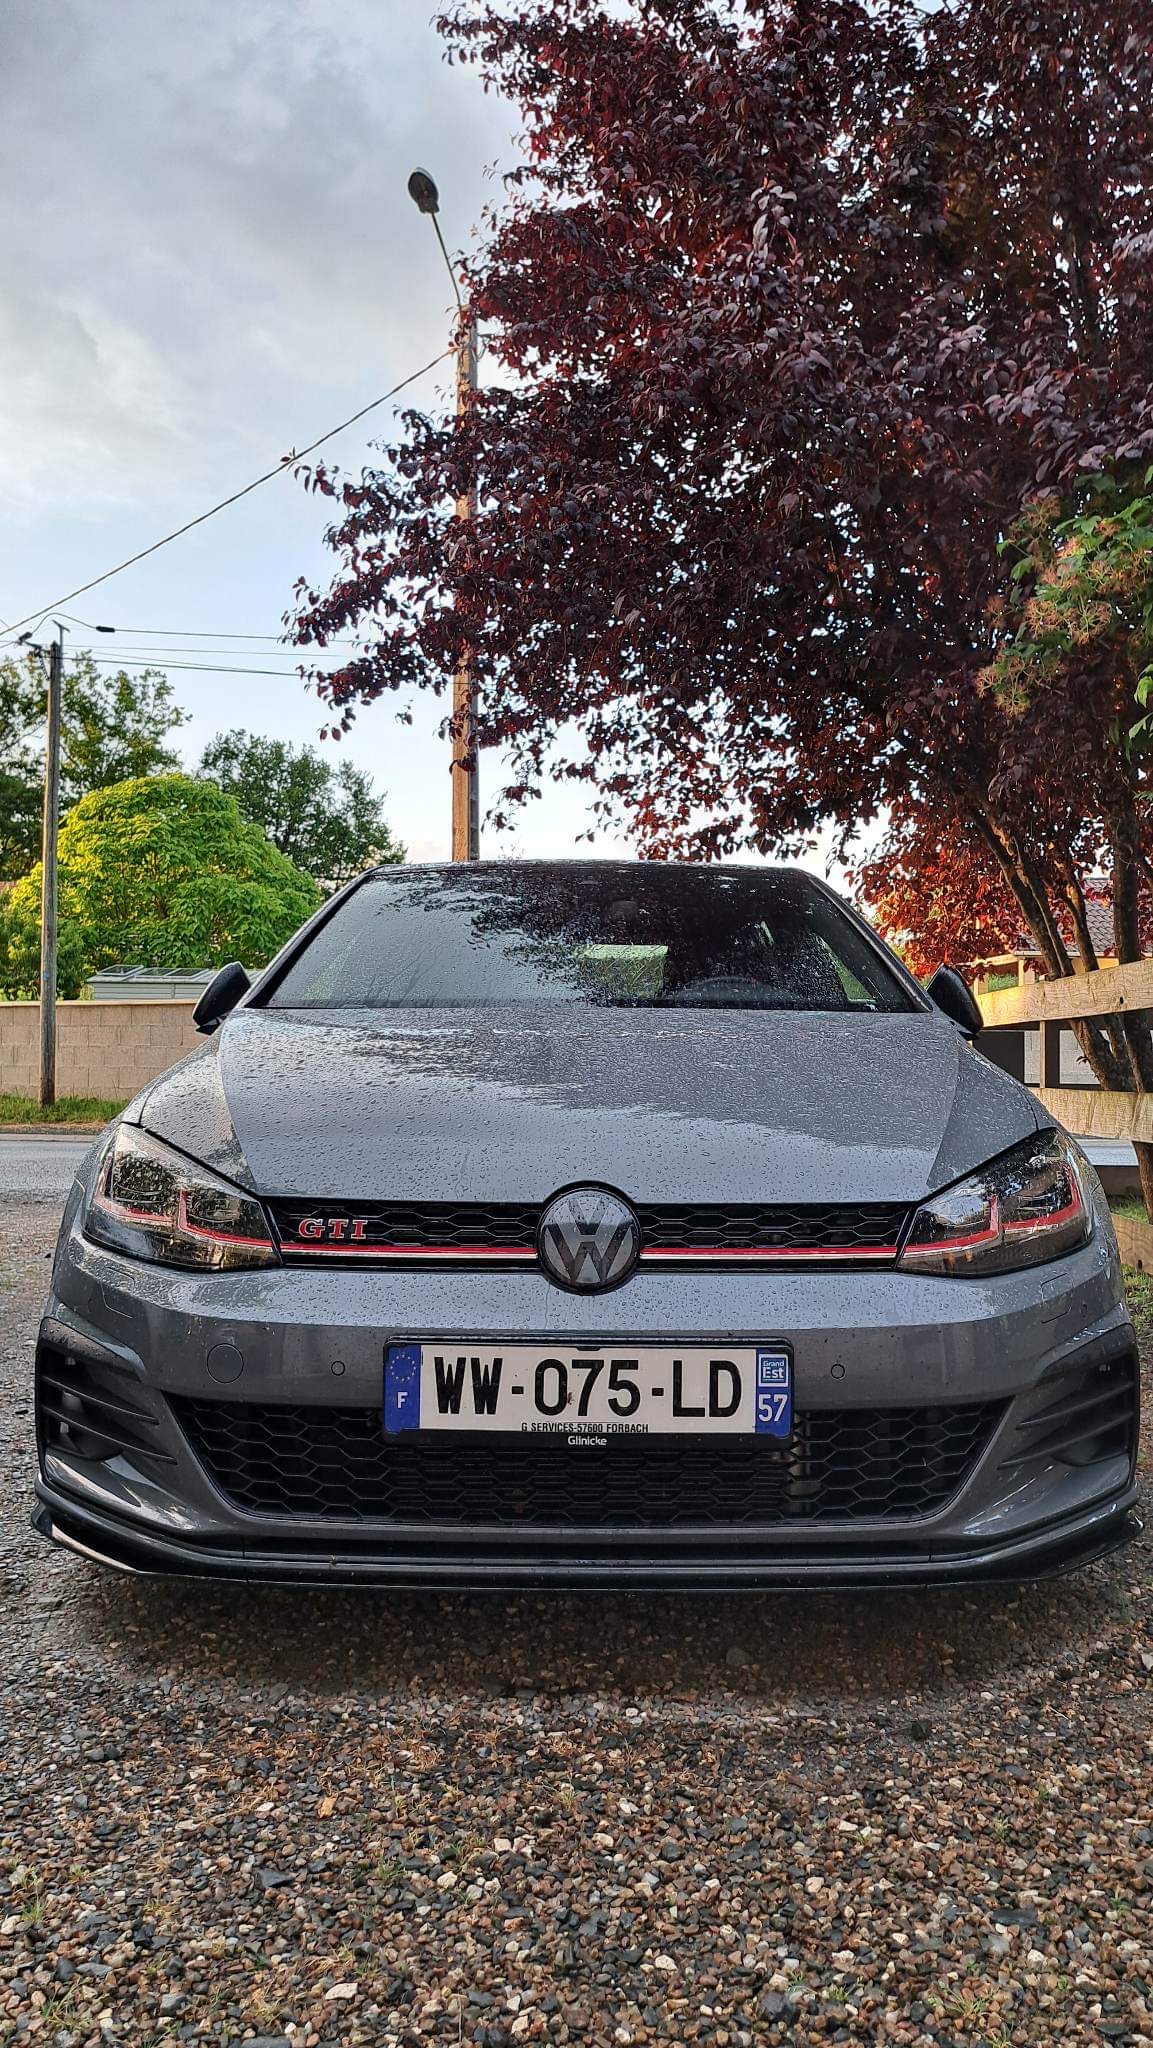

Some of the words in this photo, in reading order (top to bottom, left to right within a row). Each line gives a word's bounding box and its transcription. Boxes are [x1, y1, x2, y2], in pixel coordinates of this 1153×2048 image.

[299, 1218, 367, 1239] GTI
[543, 1192, 638, 1286] VW
[762, 1367, 785, 1379] Est
[397, 1391, 408, 1409] F
[758, 1393, 788, 1422] 57
[521, 1422, 528, 1432] G
[606, 1423, 649, 1433] FORBACH
[567, 1435, 608, 1446] Glinicke
